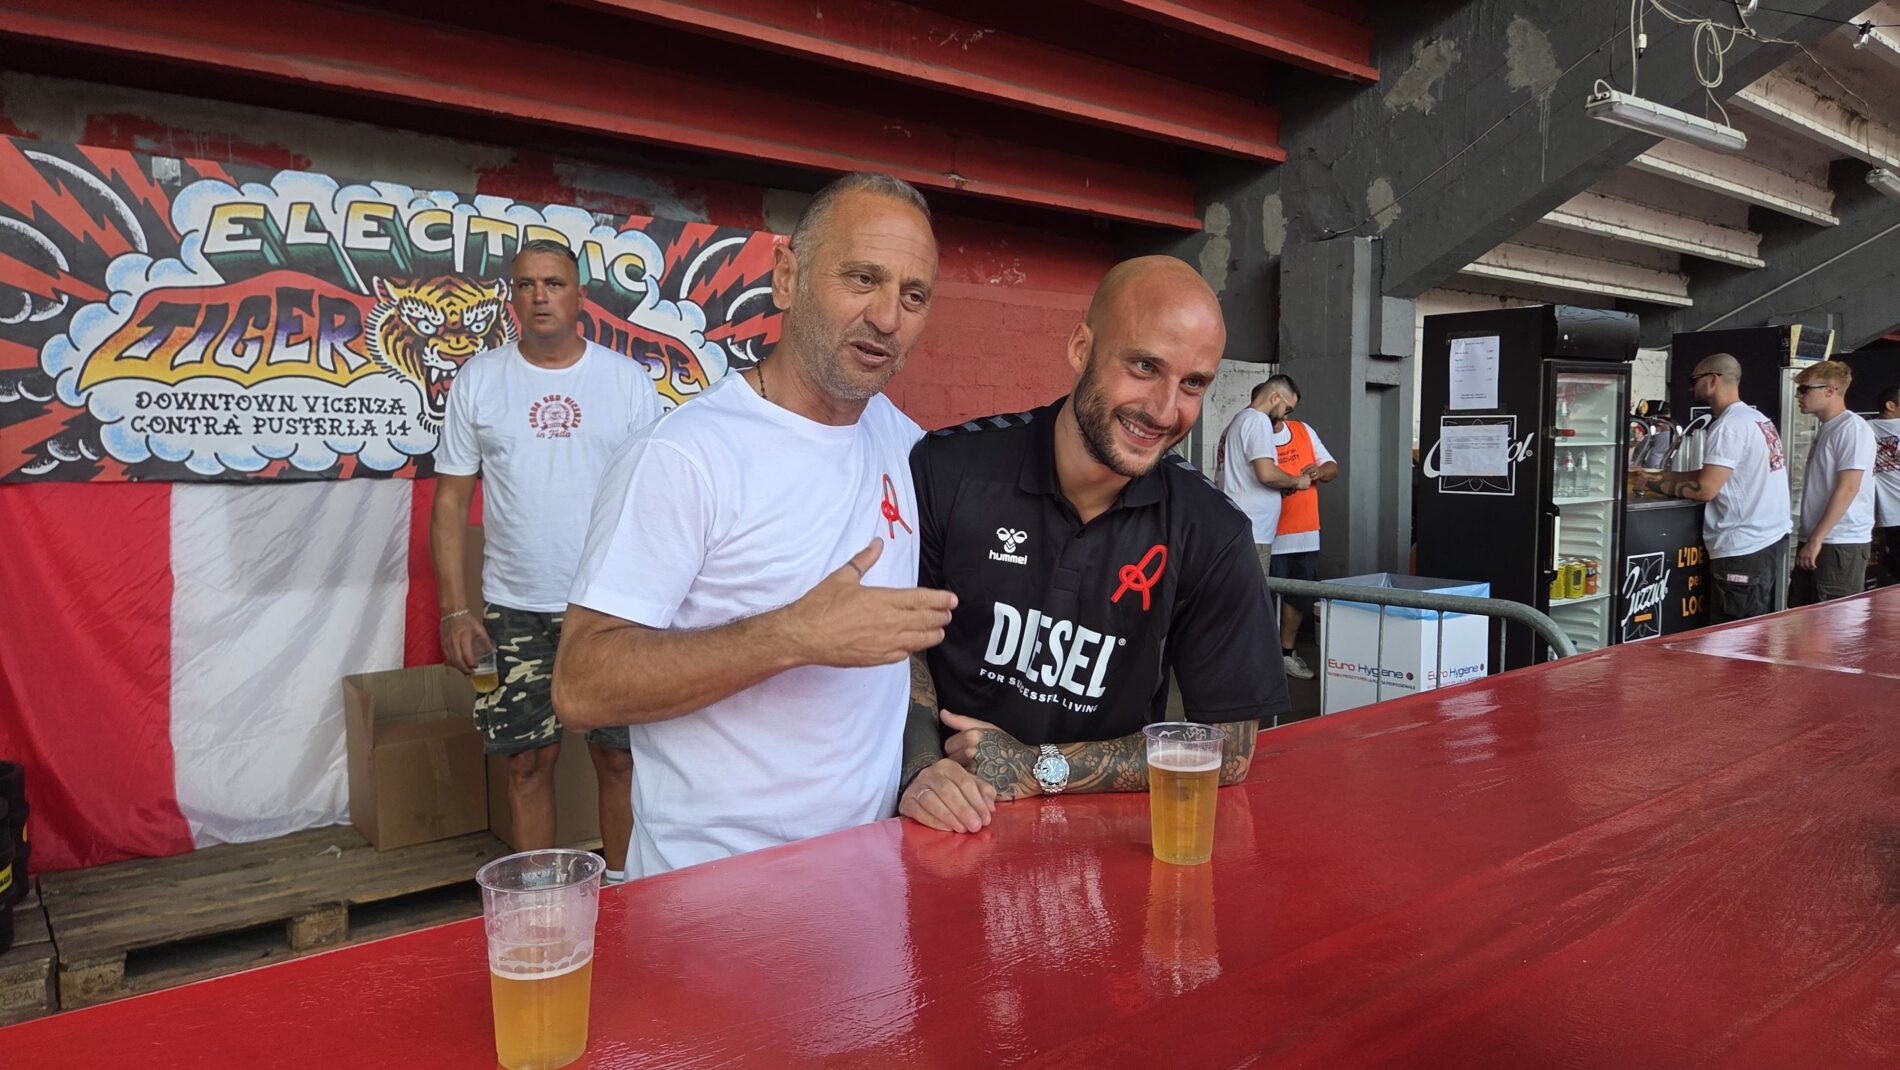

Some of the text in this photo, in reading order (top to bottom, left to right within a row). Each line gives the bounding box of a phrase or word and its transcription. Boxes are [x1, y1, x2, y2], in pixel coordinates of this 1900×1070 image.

[114, 287, 372, 374] TIGER
[576, 310, 704, 396] USE
[135, 391, 407, 416] DOWNTOWN VICENZA
[130, 414, 411, 437] CONTRÀ PUSTERLA 14
[989, 550, 1028, 565] hummel
[1678, 546, 1705, 568] L'IDE
[984, 601, 1117, 698] DIESEL
[979, 668, 1005, 683] FOR
[1328, 658, 1356, 672] Euro
[1358, 664, 1404, 680] Hygene
[1449, 665, 1479, 679] Hygiene
